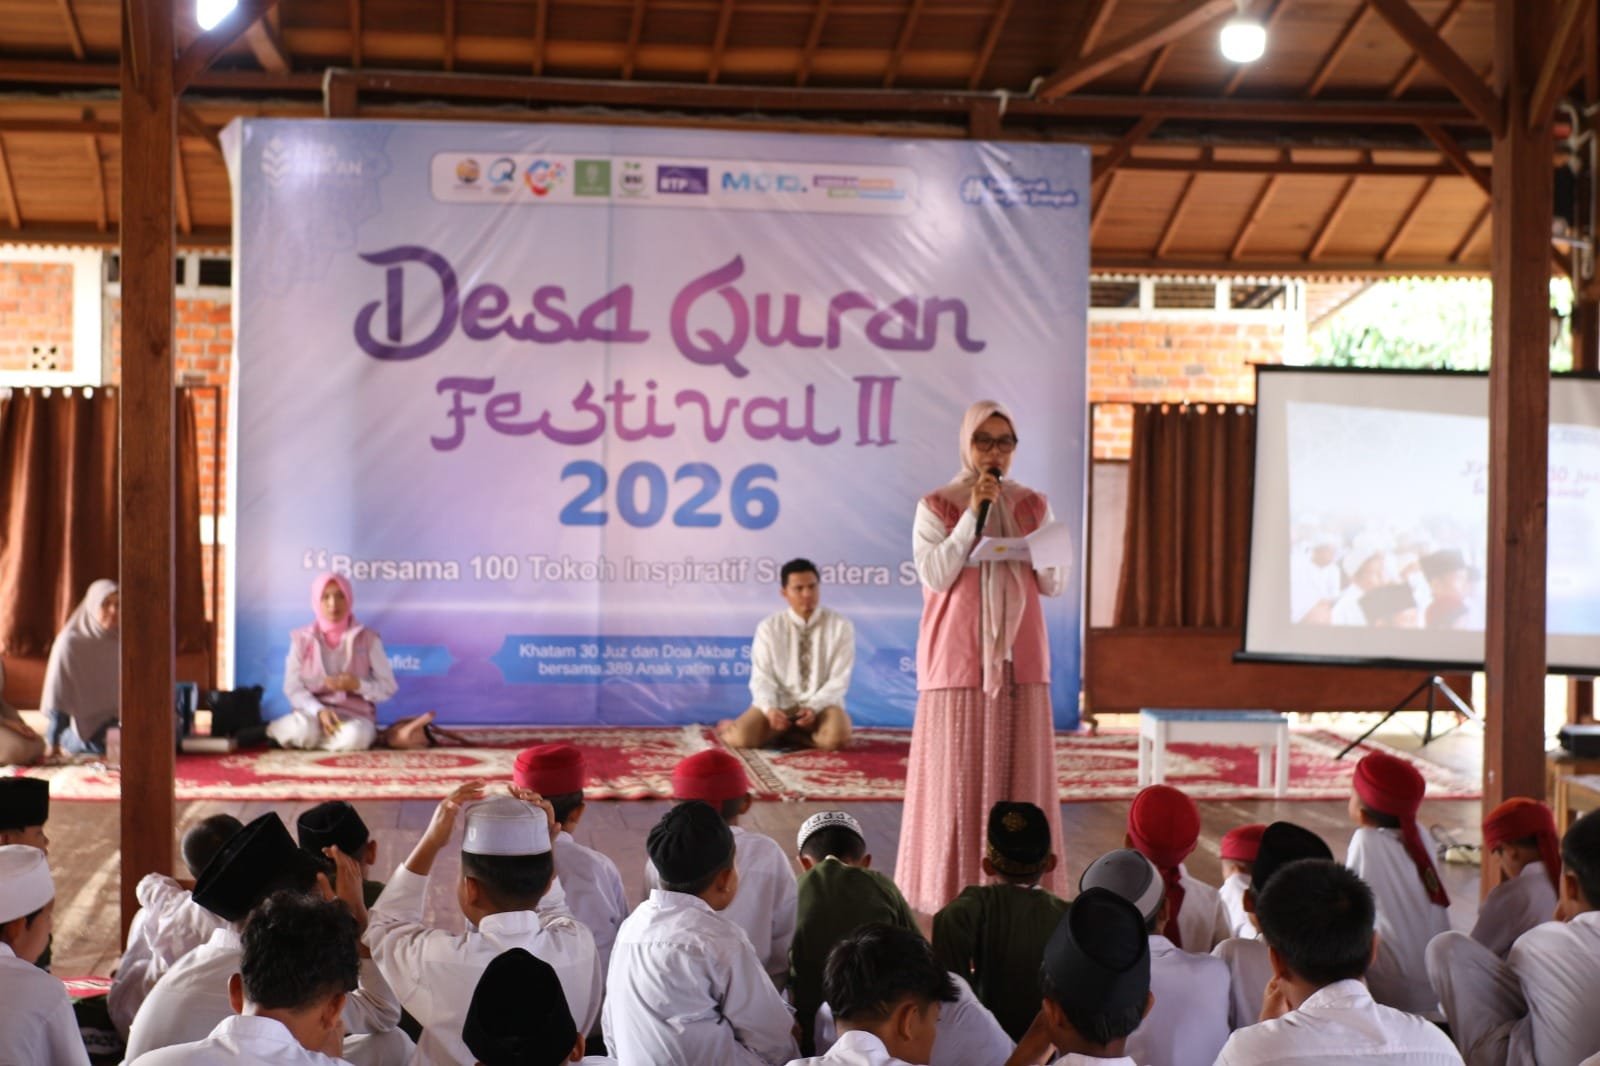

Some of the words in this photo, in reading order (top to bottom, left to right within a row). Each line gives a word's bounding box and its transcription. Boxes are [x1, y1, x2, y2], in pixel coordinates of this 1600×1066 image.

[354, 246, 649, 361] Desa
[671, 254, 986, 377] Quran
[431, 377, 841, 450] Festival
[853, 375, 900, 446] II
[559, 460, 780, 530] 2026
[471, 556, 518, 580] 100
[531, 556, 616, 581] Tokoh
[625, 557, 749, 586] Inspiratif
[756, 559, 889, 584] Satera
[519, 643, 577, 658] Khatam
[580, 643, 598, 658] 30
[603, 644, 629, 659] Juz
[632, 644, 657, 659] dan
[662, 645, 692, 660] Doa
[697, 645, 737, 660] Akbar
[538, 661, 601, 675] bersama
[637, 663, 673, 676] Anak
[677, 663, 715, 680] yatim
[718, 663, 730, 677] &
